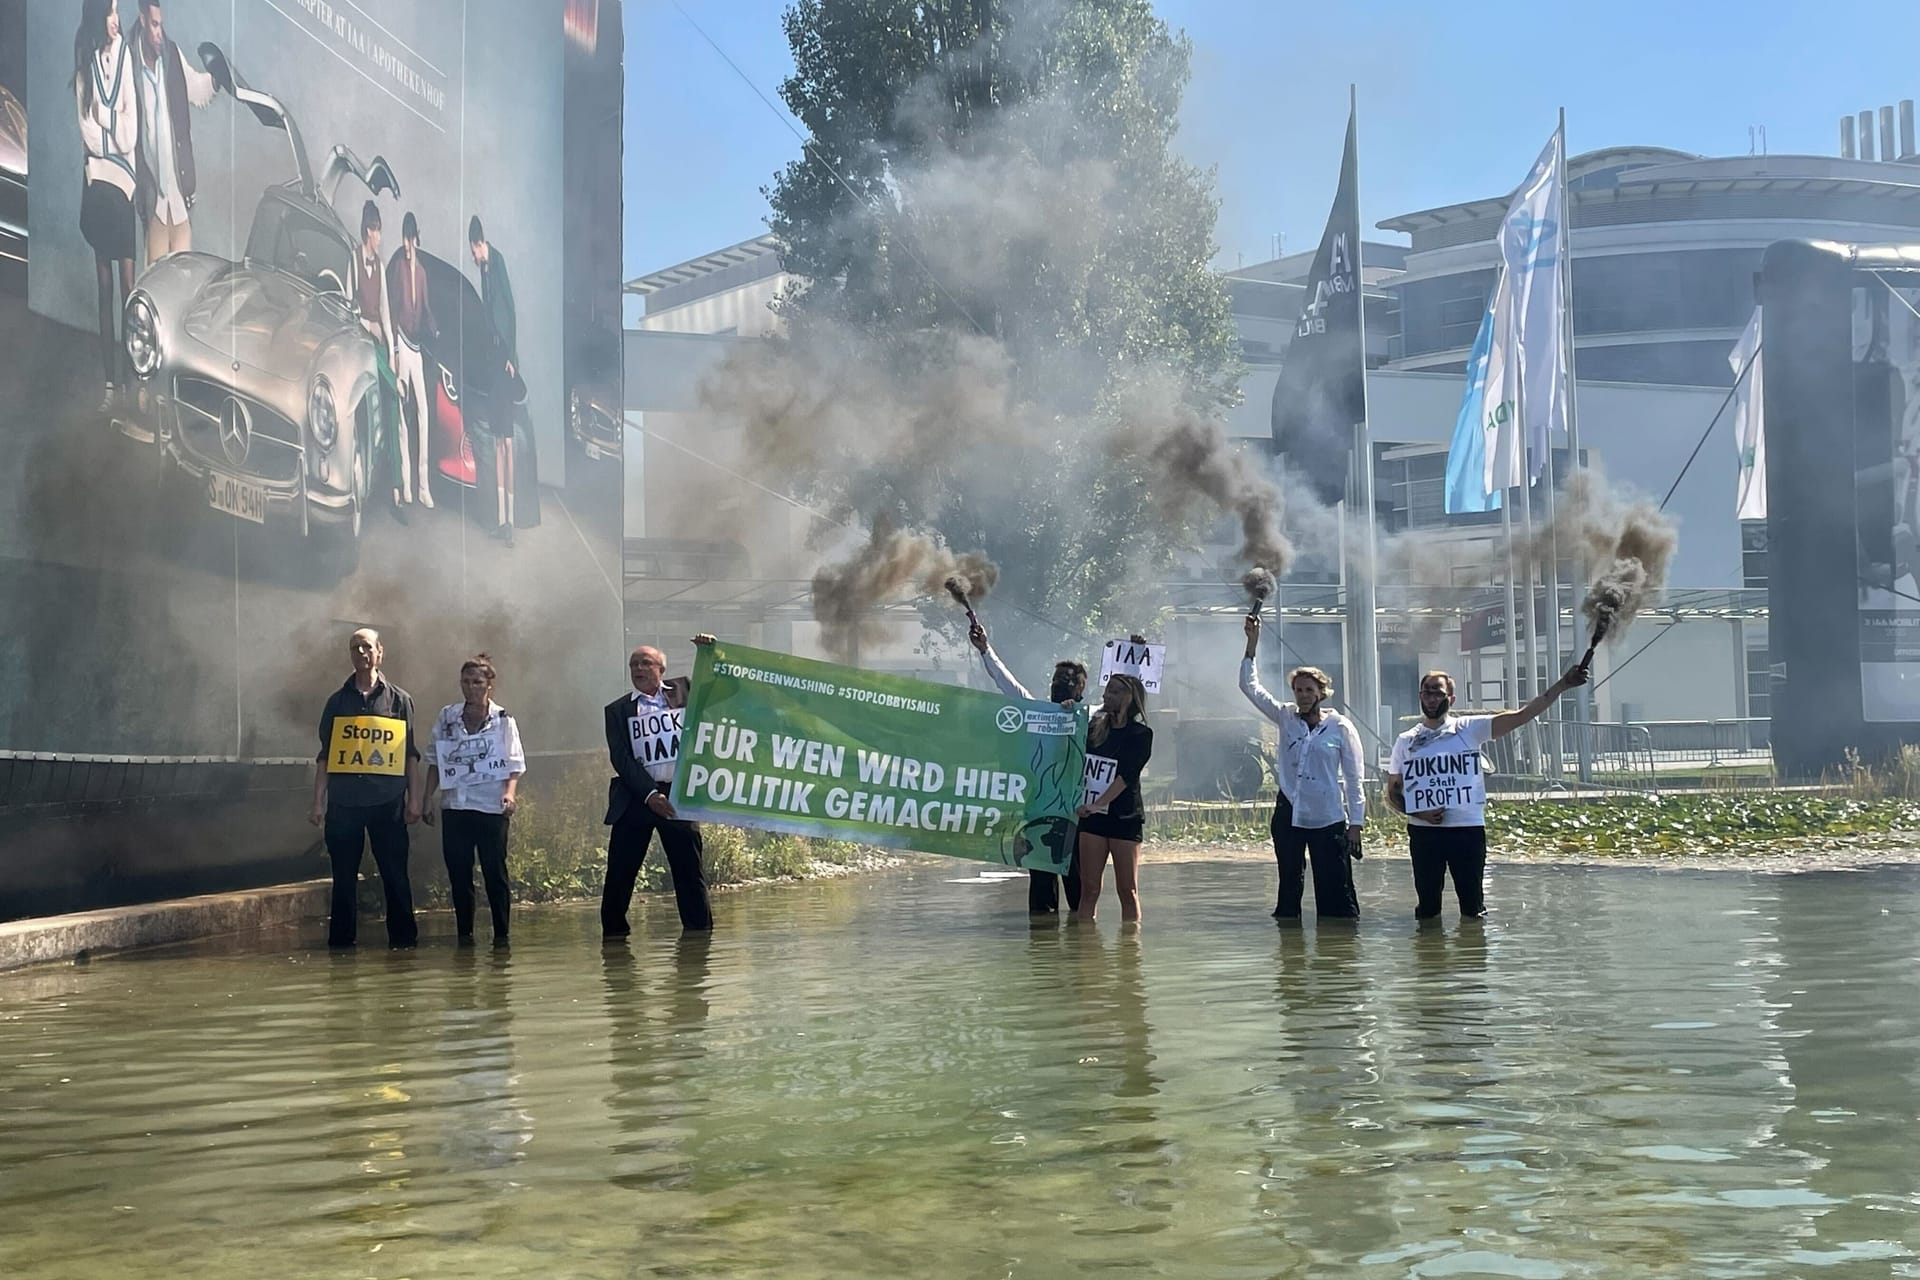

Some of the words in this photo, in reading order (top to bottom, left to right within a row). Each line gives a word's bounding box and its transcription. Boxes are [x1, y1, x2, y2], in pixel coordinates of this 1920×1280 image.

[297, 0, 333, 30] APTER
[334, 14, 347, 38] AT
[347, 22, 365, 54] IAA
[373, 44, 445, 111] APOTHEKENHOF
[1115, 644, 1150, 667] IAA
[713, 662, 835, 696] #STOPGREENWASHING
[838, 687, 941, 716] #STOPLOBBYISMUS
[632, 713, 684, 740] BLOCK
[1026, 712, 1068, 723] extinction
[1037, 723, 1074, 733] rebellion
[342, 724, 394, 745] Stopp
[644, 735, 680, 762] IAA
[694, 717, 758, 763] FÜR
[772, 733, 845, 778] WEN
[857, 749, 945, 793] WIRD
[954, 766, 1027, 804] HIER
[444, 767, 457, 778] NO
[488, 758, 506, 770] IAA
[1085, 757, 1116, 784] NFT
[1403, 752, 1480, 780] ZUKUNFT
[686, 764, 816, 814] POLITIK
[824, 787, 1002, 837] GEMACHT?
[1084, 790, 1100, 805] IT
[1414, 786, 1473, 809] PROFIT
